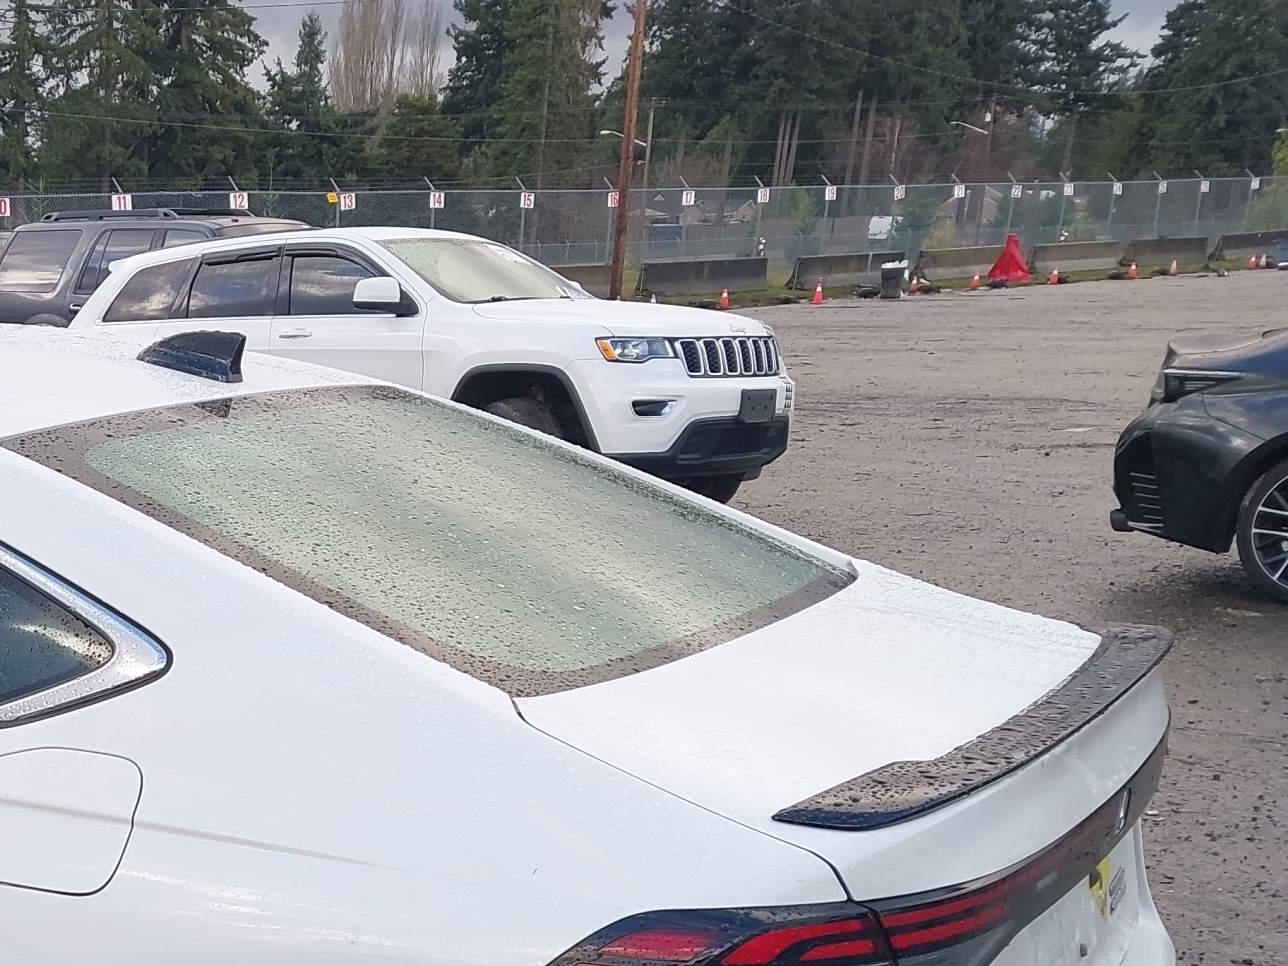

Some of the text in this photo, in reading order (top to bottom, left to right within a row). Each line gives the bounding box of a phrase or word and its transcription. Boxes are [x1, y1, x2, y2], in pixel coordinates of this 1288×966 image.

[432, 192, 442, 207] 14
[609, 193, 619, 206] 16
[759, 190, 768, 202] 18
[826, 187, 835, 200] 19
[895, 186, 905, 199] 20
[116, 196, 126, 210] 11
[233, 193, 245, 209] 12
[342, 194, 354, 209] 13
[522, 193, 532, 207] 15
